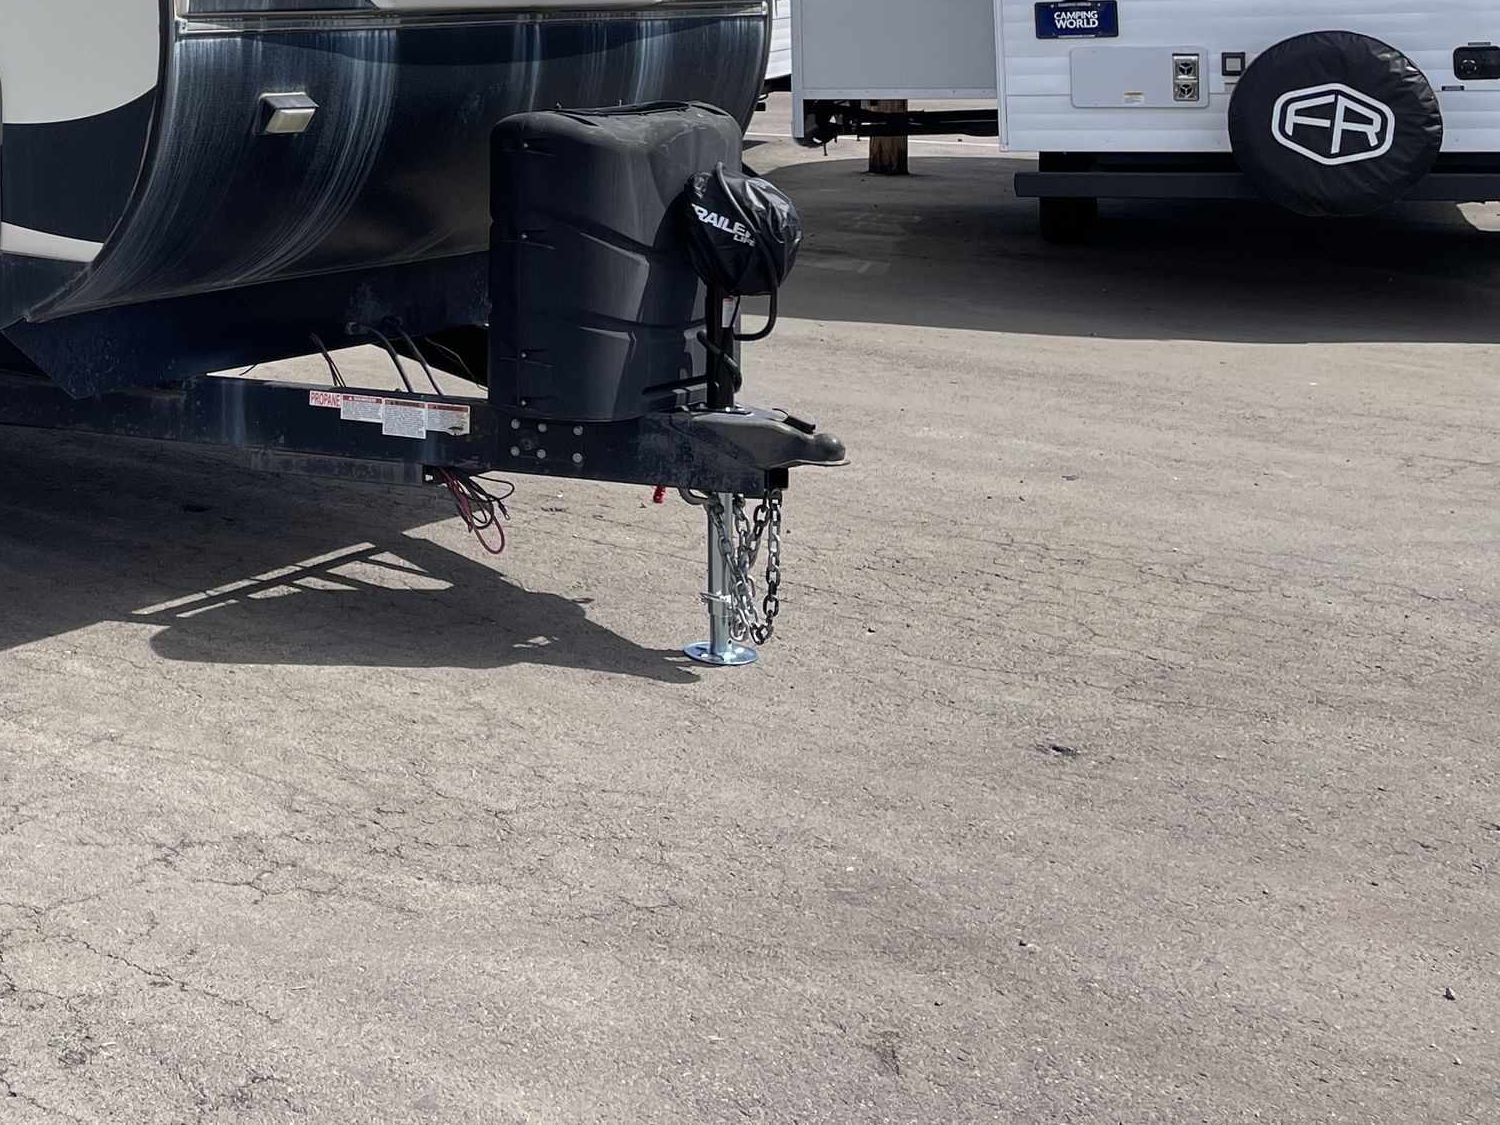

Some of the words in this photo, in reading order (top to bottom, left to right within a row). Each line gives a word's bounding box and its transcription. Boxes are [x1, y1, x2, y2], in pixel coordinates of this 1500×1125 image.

[1054, 11, 1098, 20] CAMPING
[1055, 19, 1098, 29] WORLD
[1284, 94, 1381, 155] FR
[691, 203, 752, 239] RAILE
[311, 391, 340, 407] PROPANE
